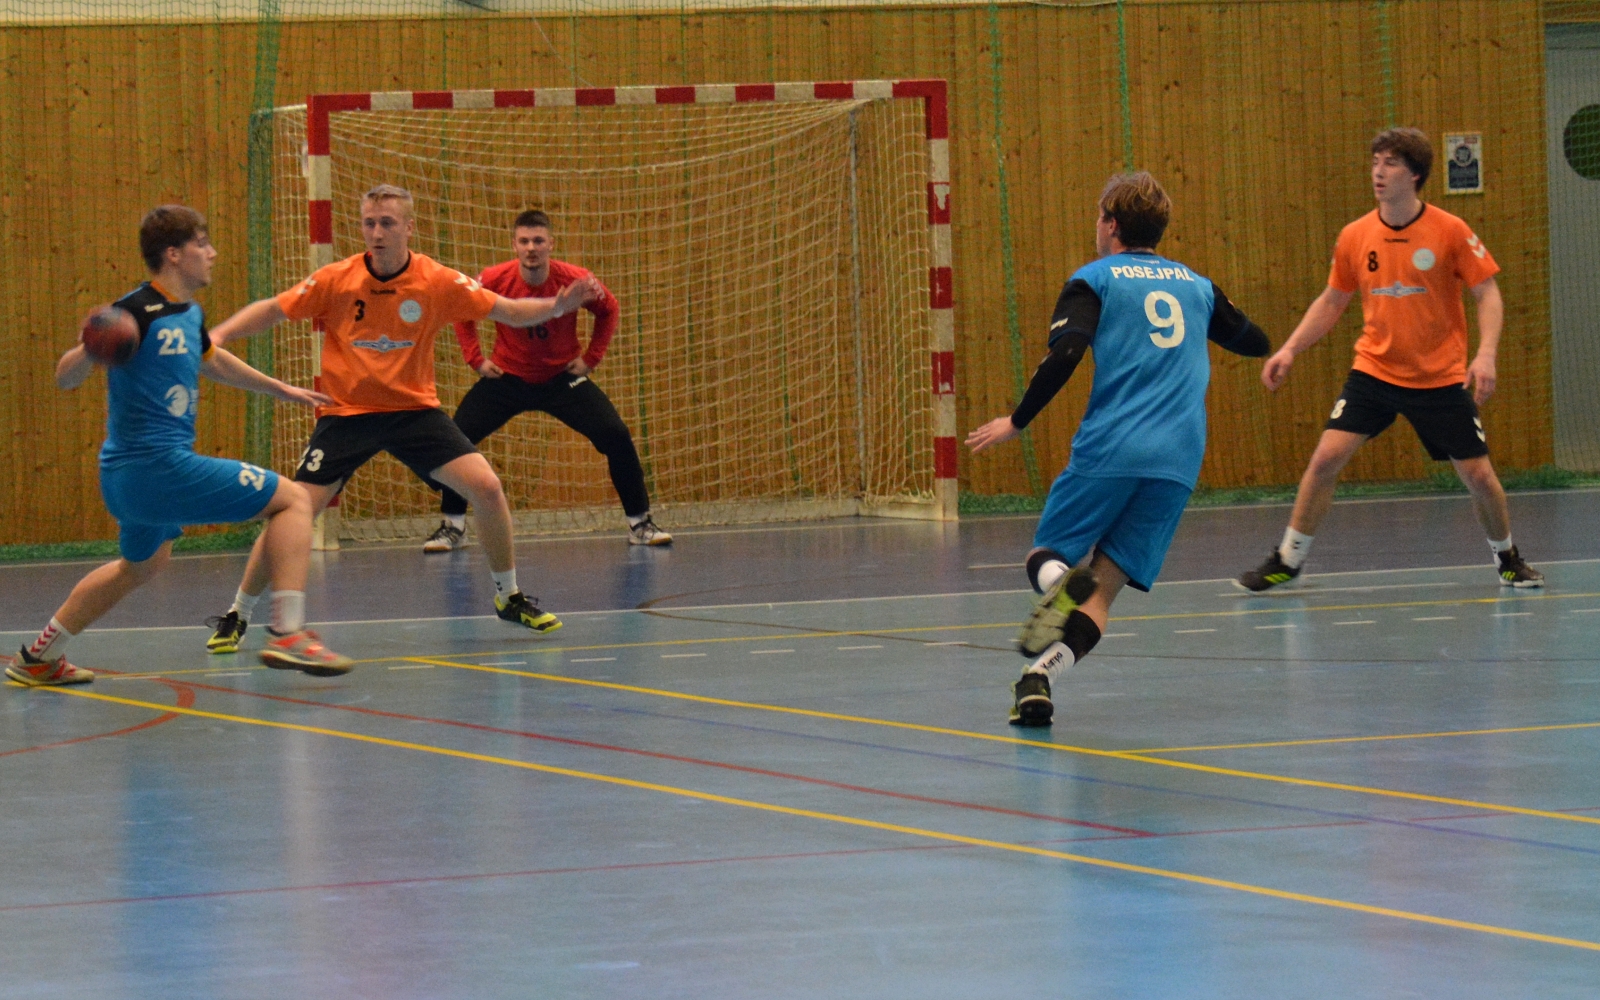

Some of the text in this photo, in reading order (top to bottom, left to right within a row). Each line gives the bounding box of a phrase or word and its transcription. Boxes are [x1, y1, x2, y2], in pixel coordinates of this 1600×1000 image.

[1367, 250, 1379, 272] 8
[1110, 265, 1195, 282] POSEJPAL
[354, 299, 366, 322] 3
[1144, 290, 1186, 349] 9
[157, 328, 189, 356] 22
[1329, 399, 1347, 420] 8
[306, 448, 325, 472] 3
